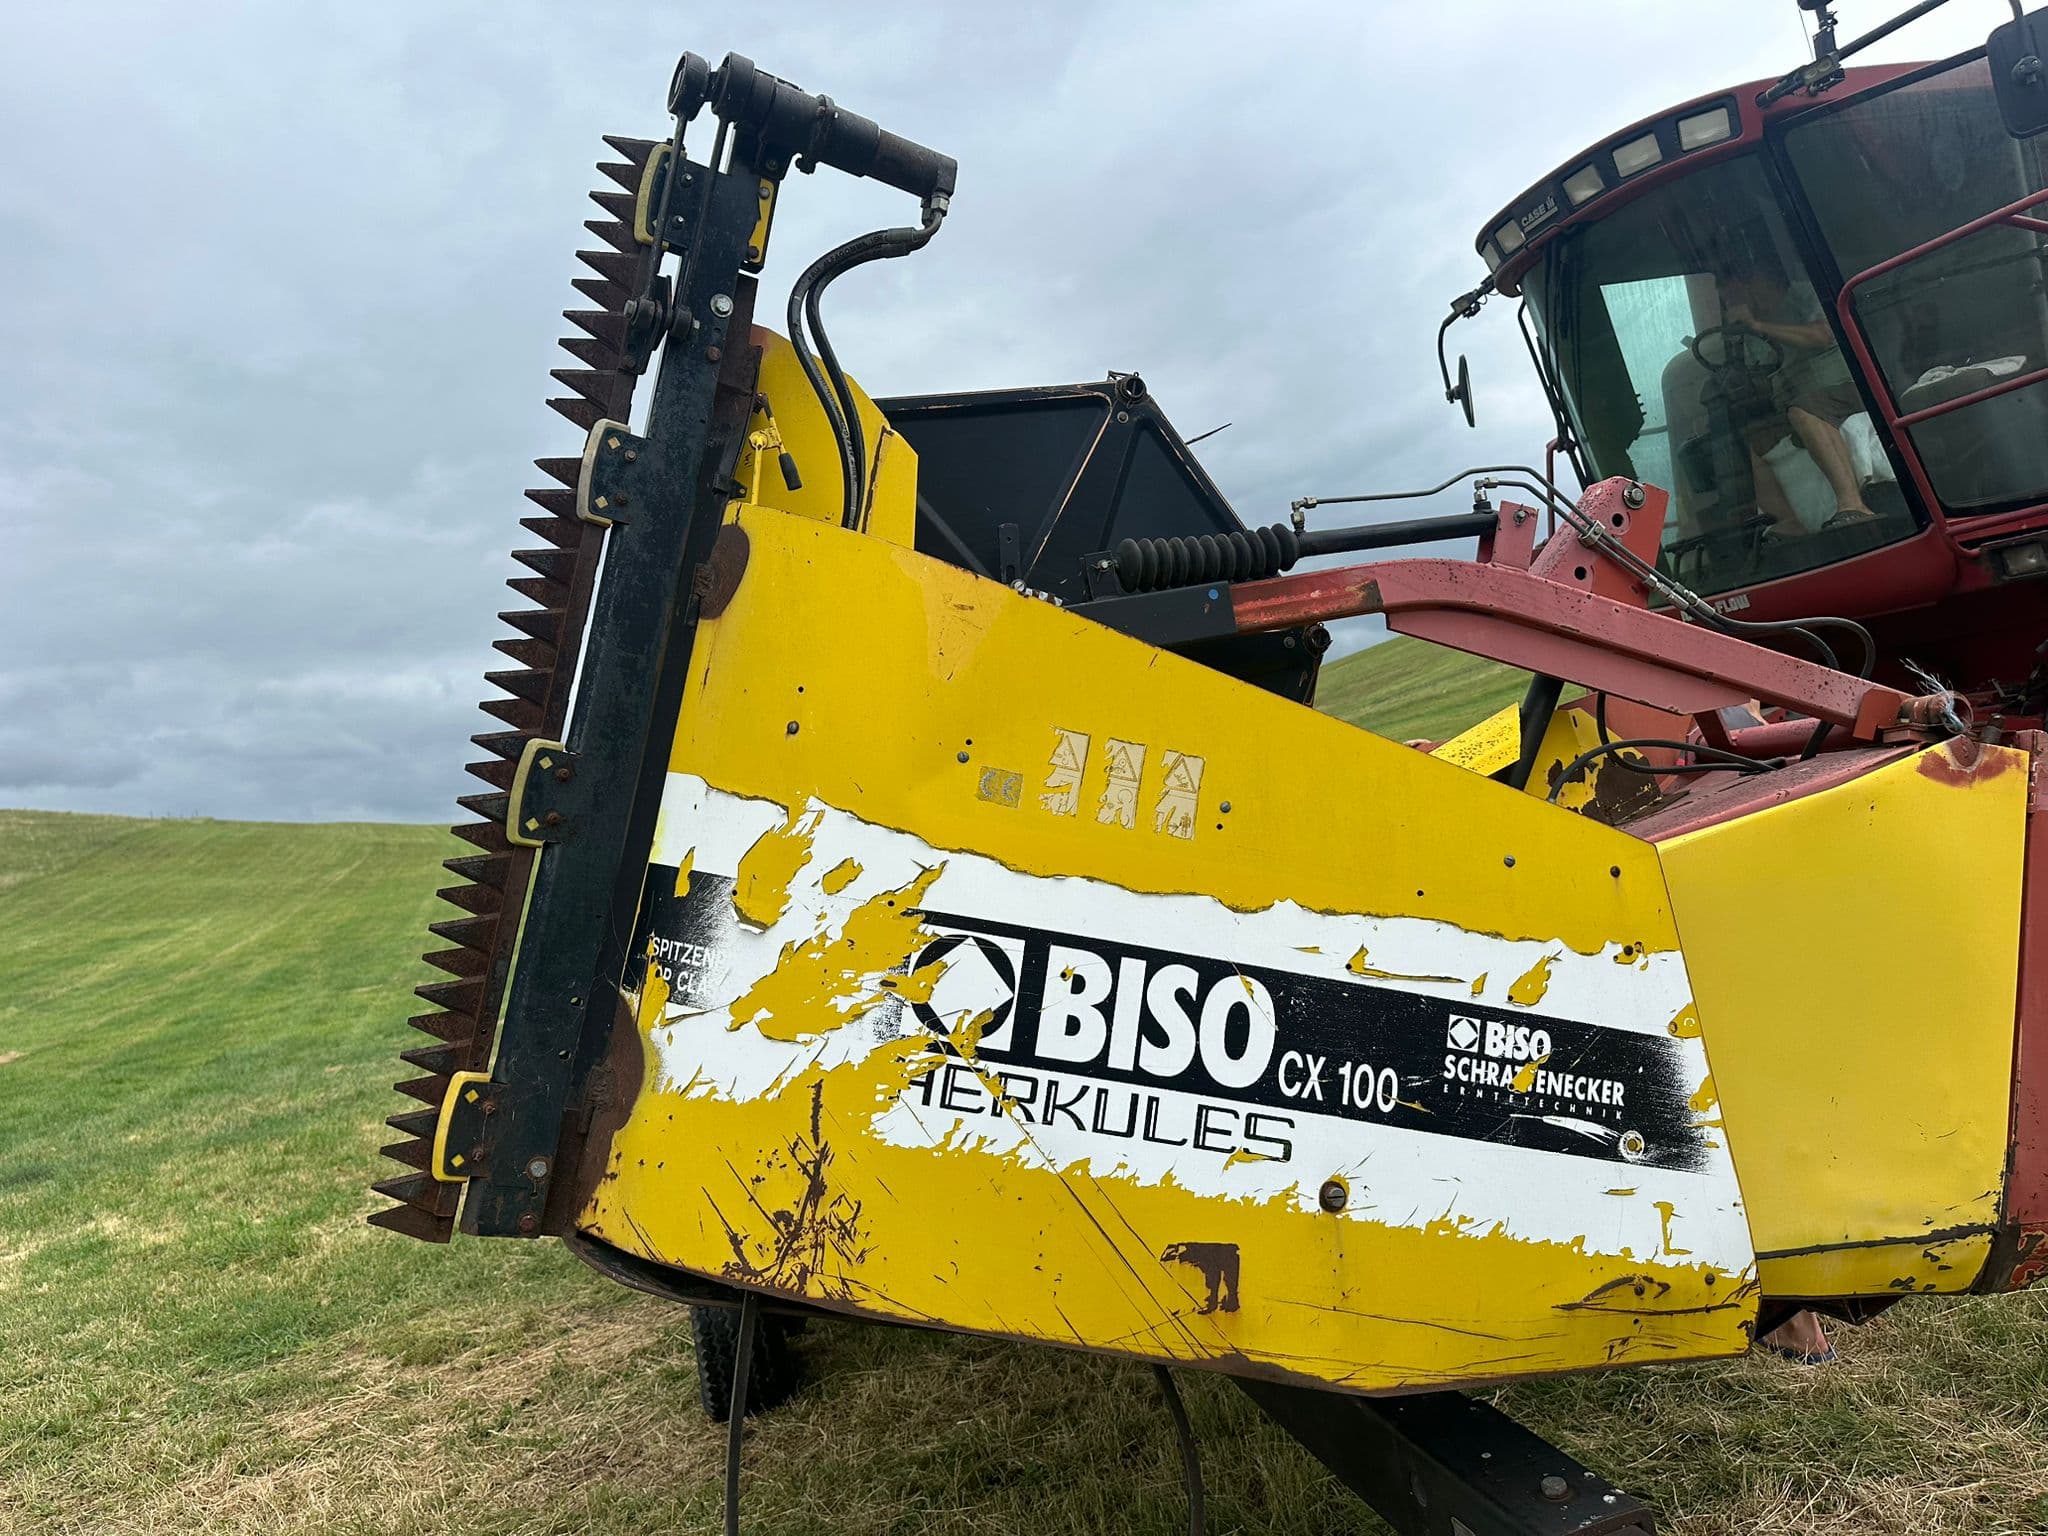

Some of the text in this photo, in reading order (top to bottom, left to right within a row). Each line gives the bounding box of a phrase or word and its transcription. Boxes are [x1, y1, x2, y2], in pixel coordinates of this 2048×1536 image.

[1521, 203, 1546, 227] CASE
[1034, 944, 1398, 1114] BISO CX 100
[1484, 1020, 1552, 1061] BISO
[1443, 1054, 1625, 1107] SCHRAENECKER
